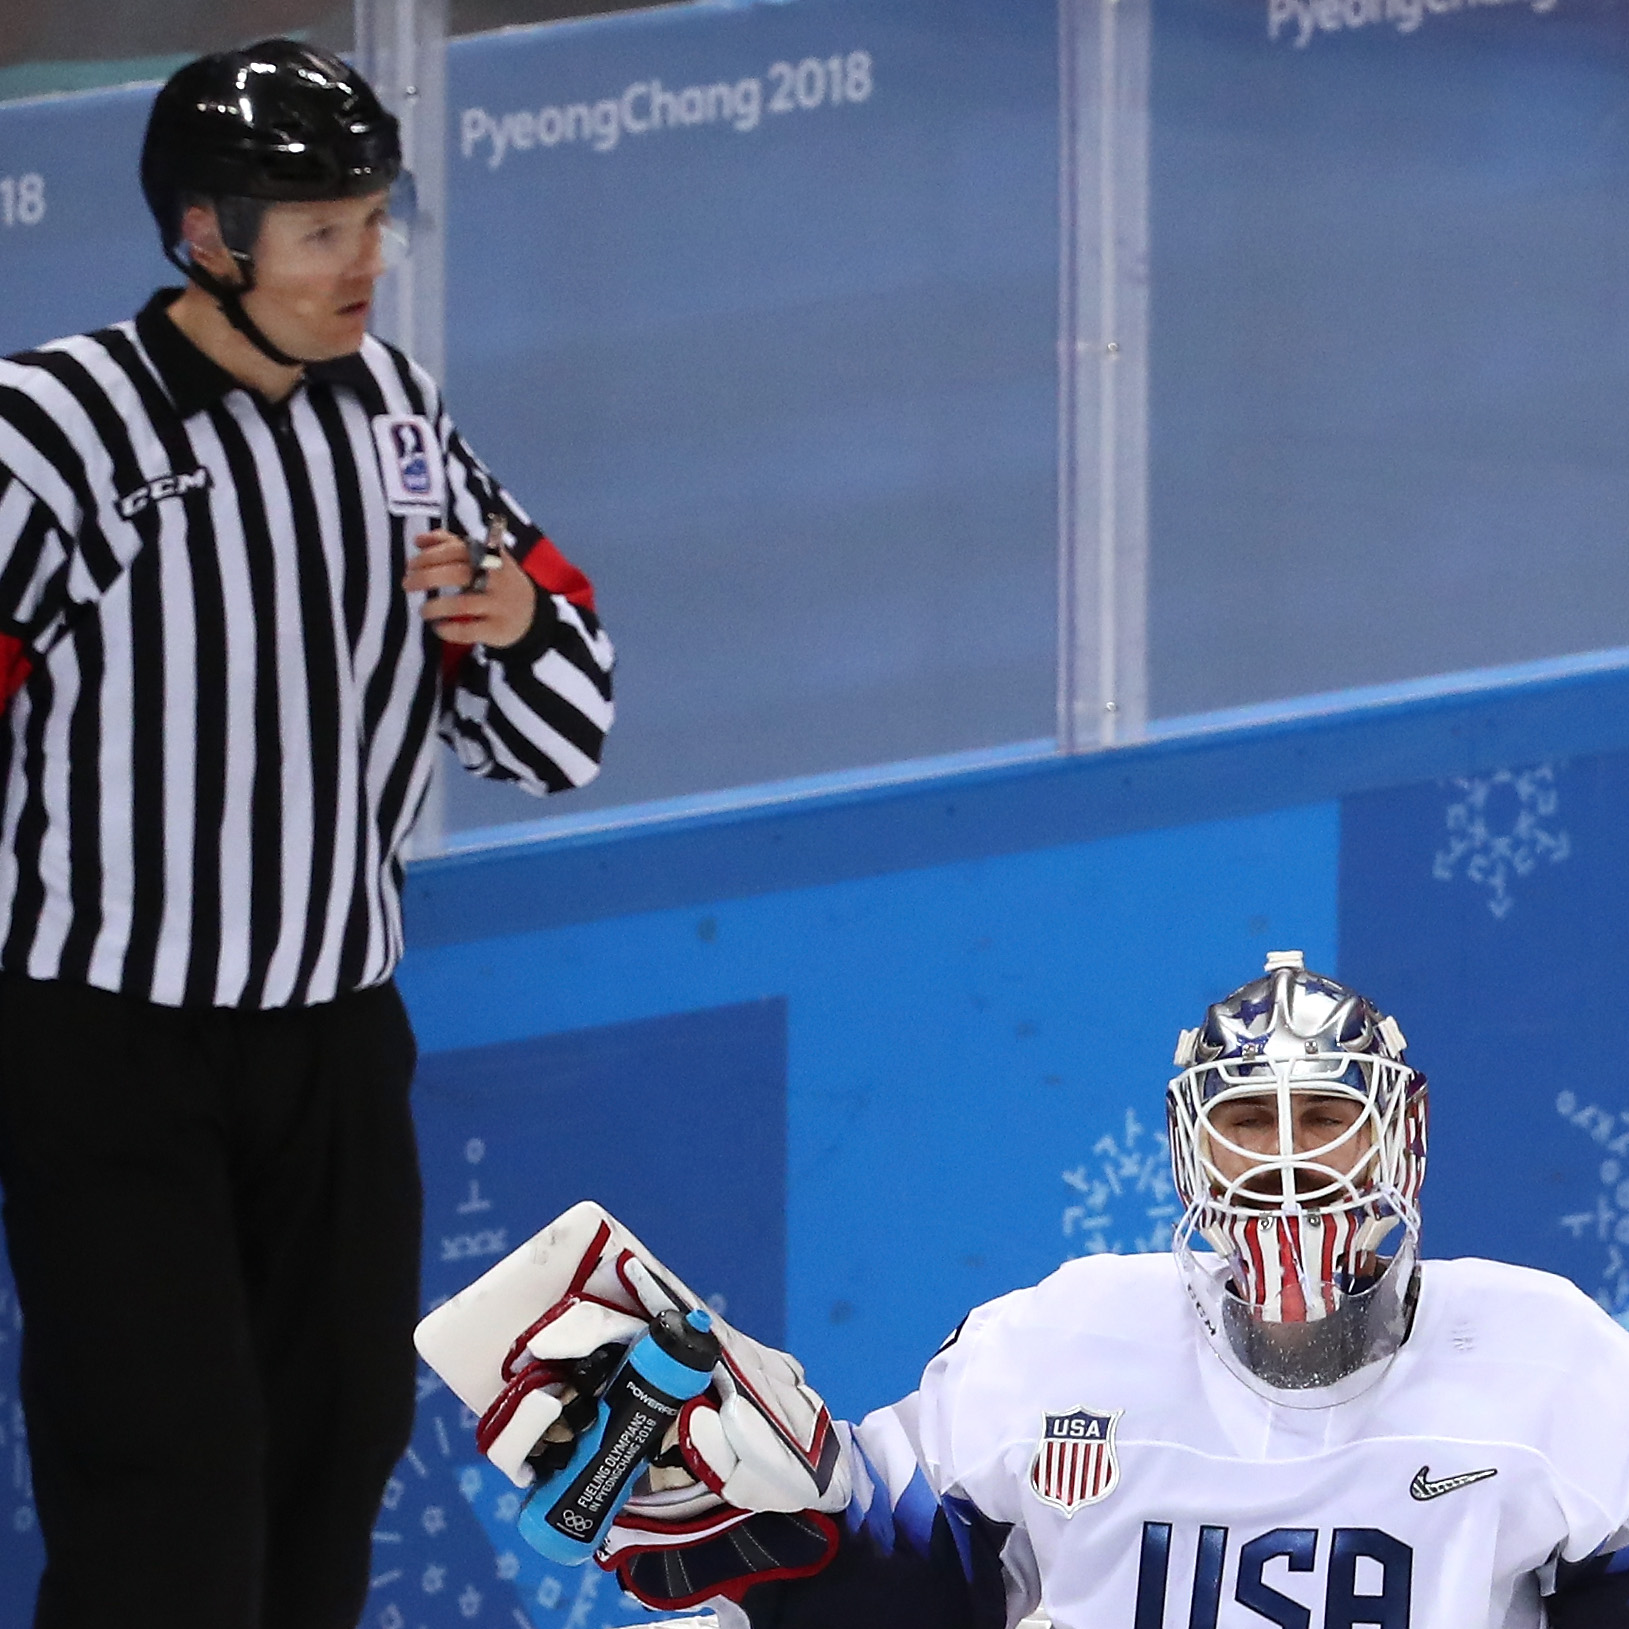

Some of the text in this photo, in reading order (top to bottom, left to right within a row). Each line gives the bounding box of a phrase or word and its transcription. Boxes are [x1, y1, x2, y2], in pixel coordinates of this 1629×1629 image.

[1268, 0, 1557, 49] Pyeong
[461, 50, 873, 169] PyeongChang 2018
[121, 468, 207, 516] CCM
[577, 1411, 648, 1508] FUELING OLYMPIANS
[1053, 1418, 1100, 1437] USA
[588, 1418, 658, 1513] IN PYEONGCHANG 2018
